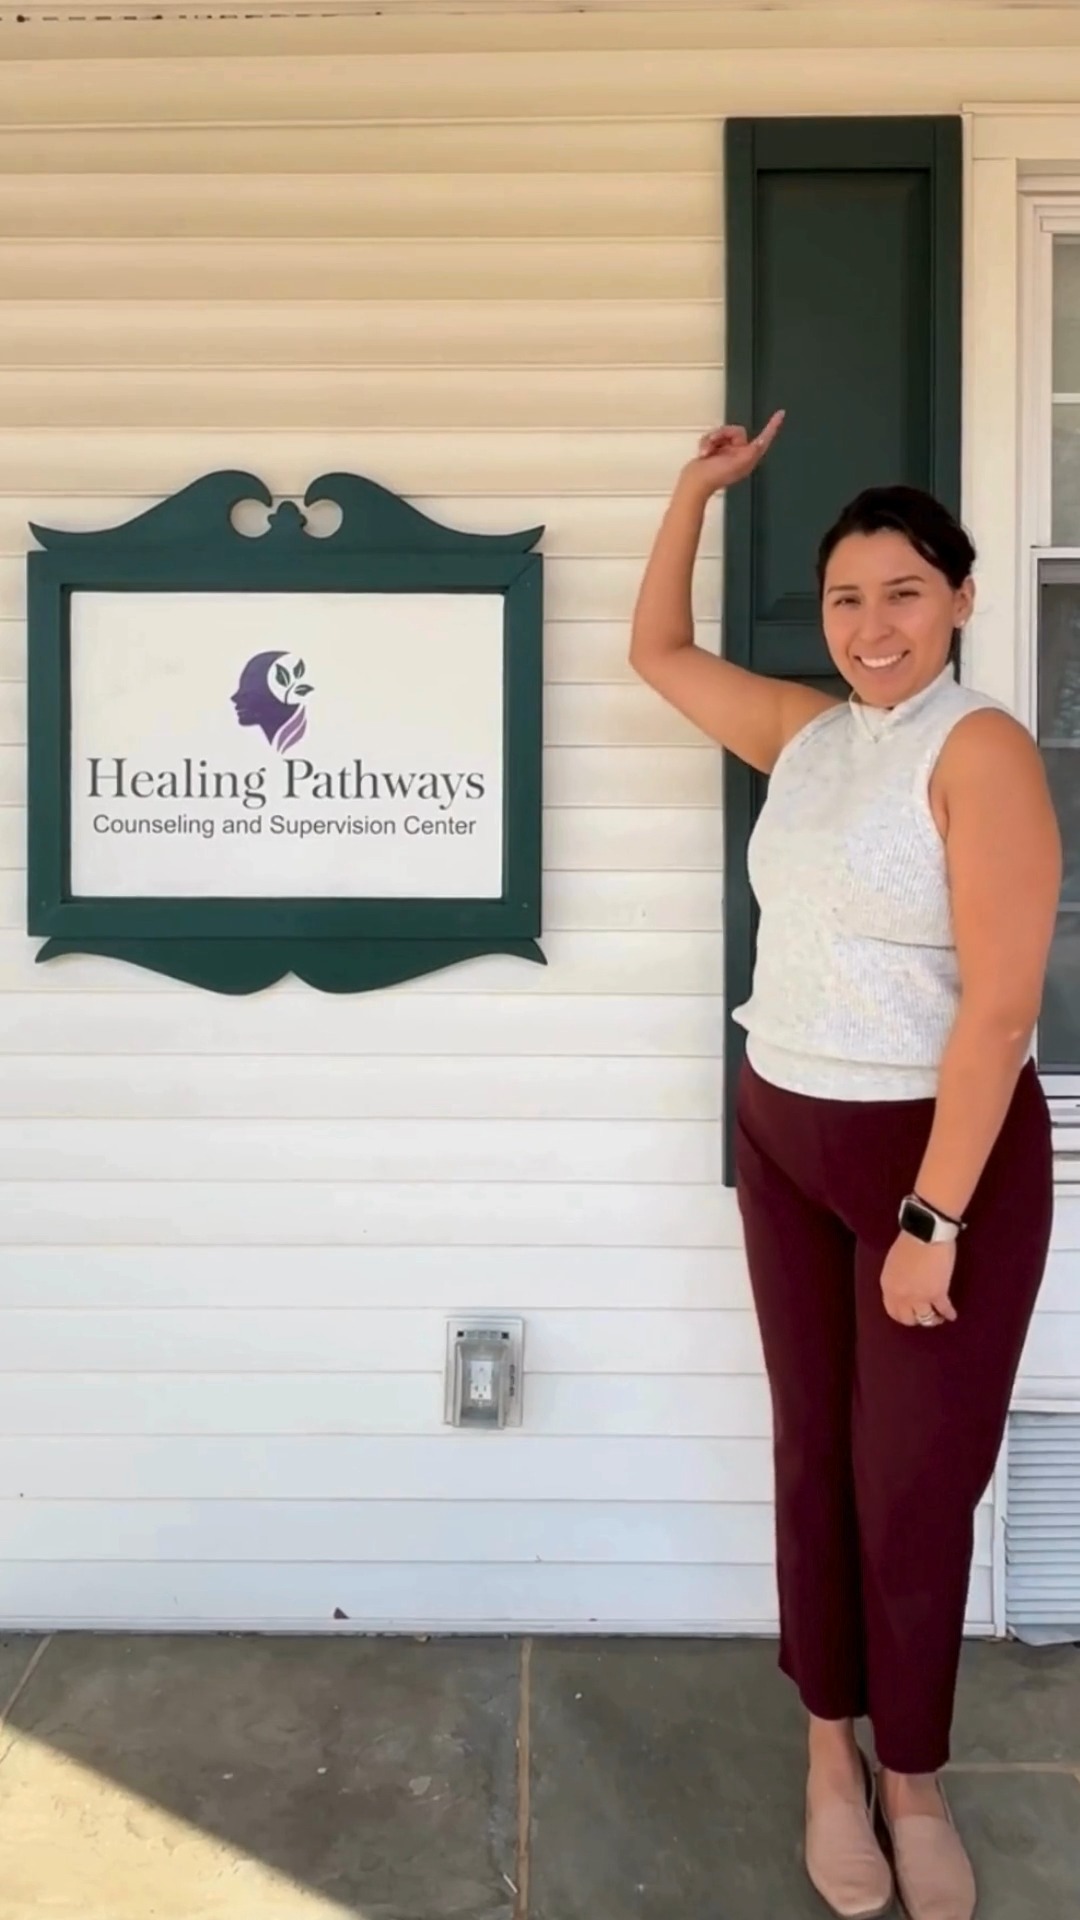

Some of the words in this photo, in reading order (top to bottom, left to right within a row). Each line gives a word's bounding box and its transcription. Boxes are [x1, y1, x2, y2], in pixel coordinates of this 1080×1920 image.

[87, 757, 267, 809] Healing
[283, 758, 486, 811] Pathways
[92, 814, 214, 839] Counseling
[222, 815, 262, 834] and
[269, 814, 396, 839] Supervision
[403, 815, 477, 836] Center
